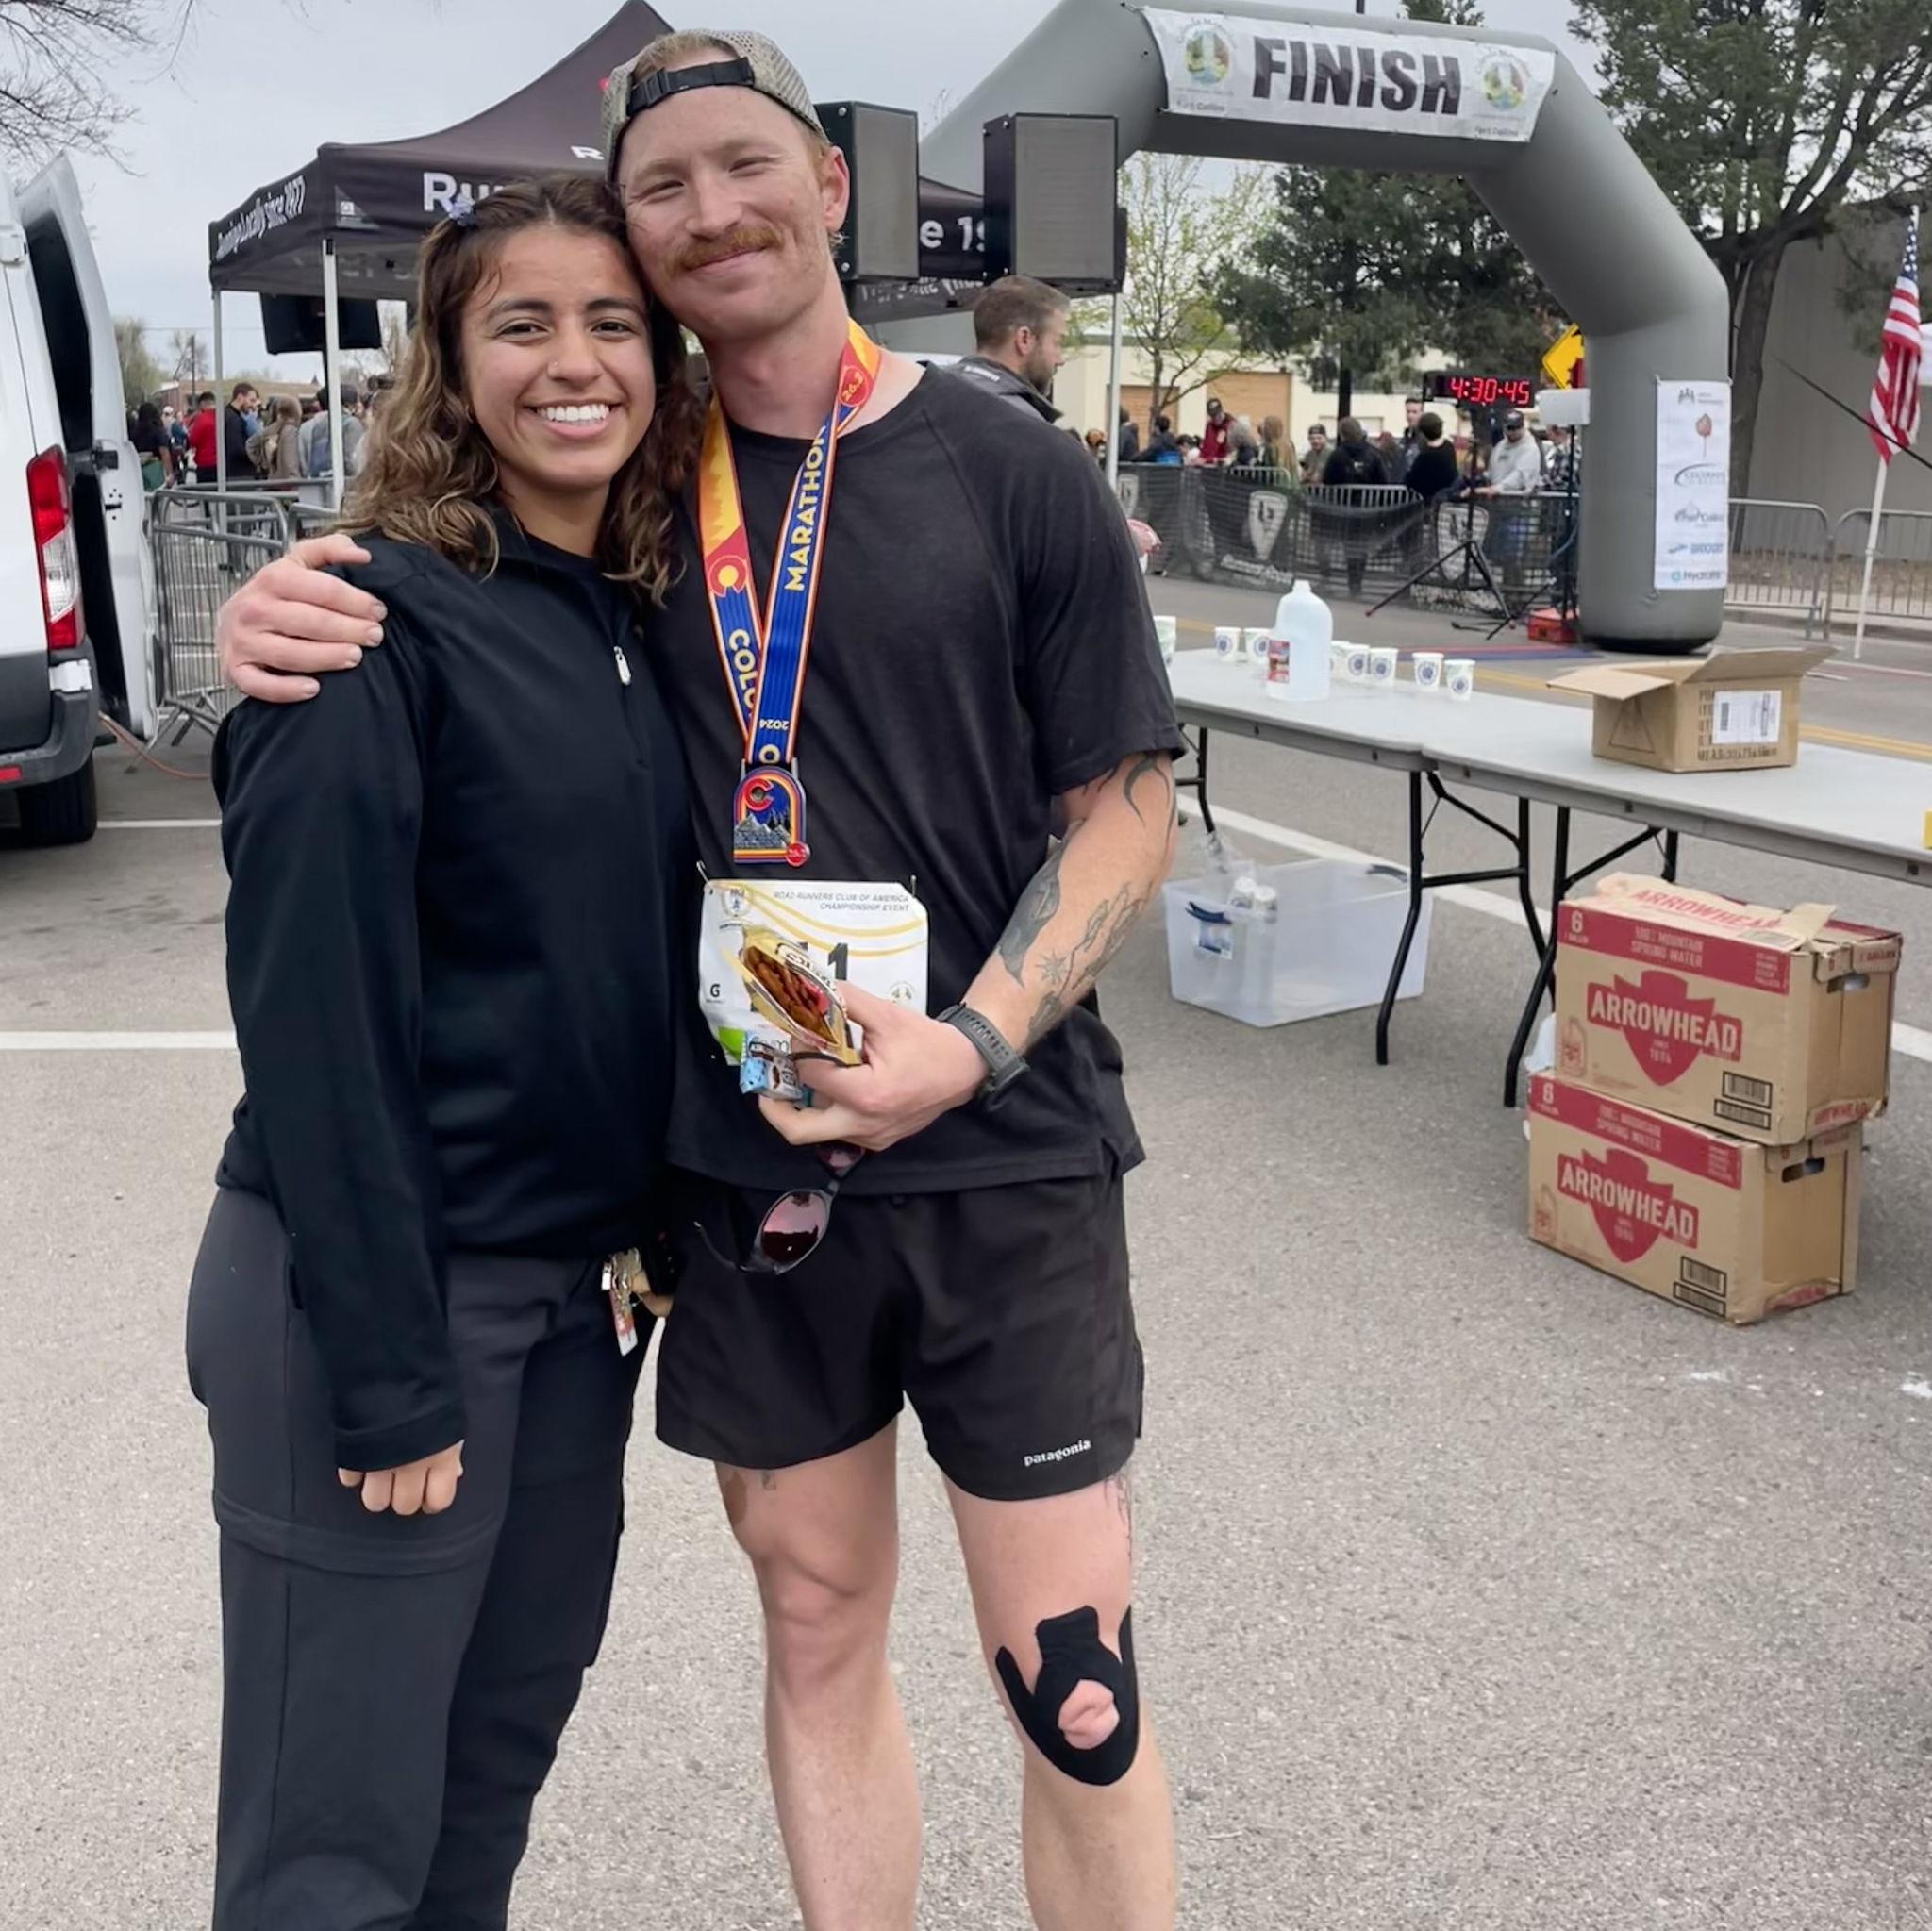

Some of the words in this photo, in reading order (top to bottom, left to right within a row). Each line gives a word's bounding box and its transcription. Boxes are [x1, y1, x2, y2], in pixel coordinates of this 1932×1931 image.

[1253, 36, 1461, 115] FINISH
[423, 172, 505, 213] Ru
[728, 628, 758, 713] COLO
[759, 718, 790, 730] 2024
[796, 891, 833, 901] RUNNERS
[835, 892, 858, 901] CLUB
[858, 893, 871, 902] OF
[873, 893, 909, 903] AMERICA
[819, 902, 881, 911] CHAMPIONSHIP
[882, 904, 910, 912] EVENT
[1571, 910, 1584, 933] 6
[1669, 947, 1703, 968] WATER
[1591, 990, 1738, 1054] ARROWHEAD
[1561, 1161, 1694, 1240] ARROWHEAD
[1024, 1440, 1091, 1467] patagonia
